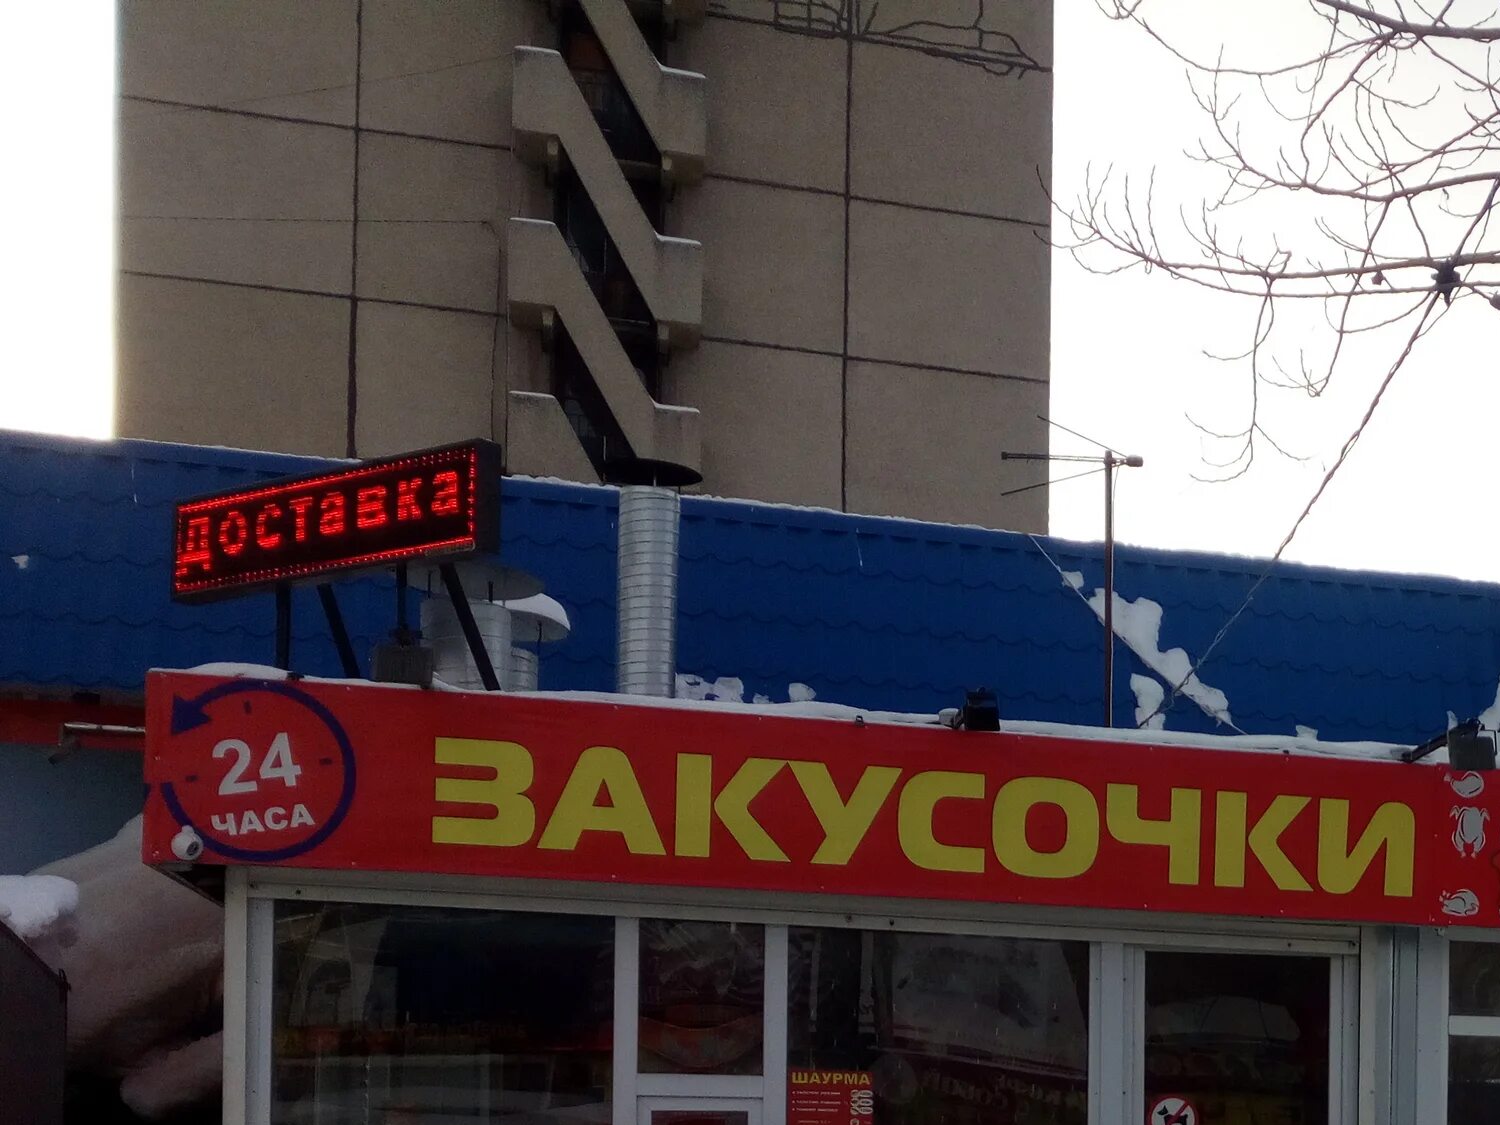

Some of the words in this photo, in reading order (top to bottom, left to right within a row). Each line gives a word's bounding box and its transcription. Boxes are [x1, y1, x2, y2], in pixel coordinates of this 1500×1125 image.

[210, 731, 302, 796] 24
[210, 803, 316, 837] ЧАСА
[431, 736, 1416, 898] ЗАКУСОЧКИ
[791, 1072, 871, 1085] ШАУРМА
